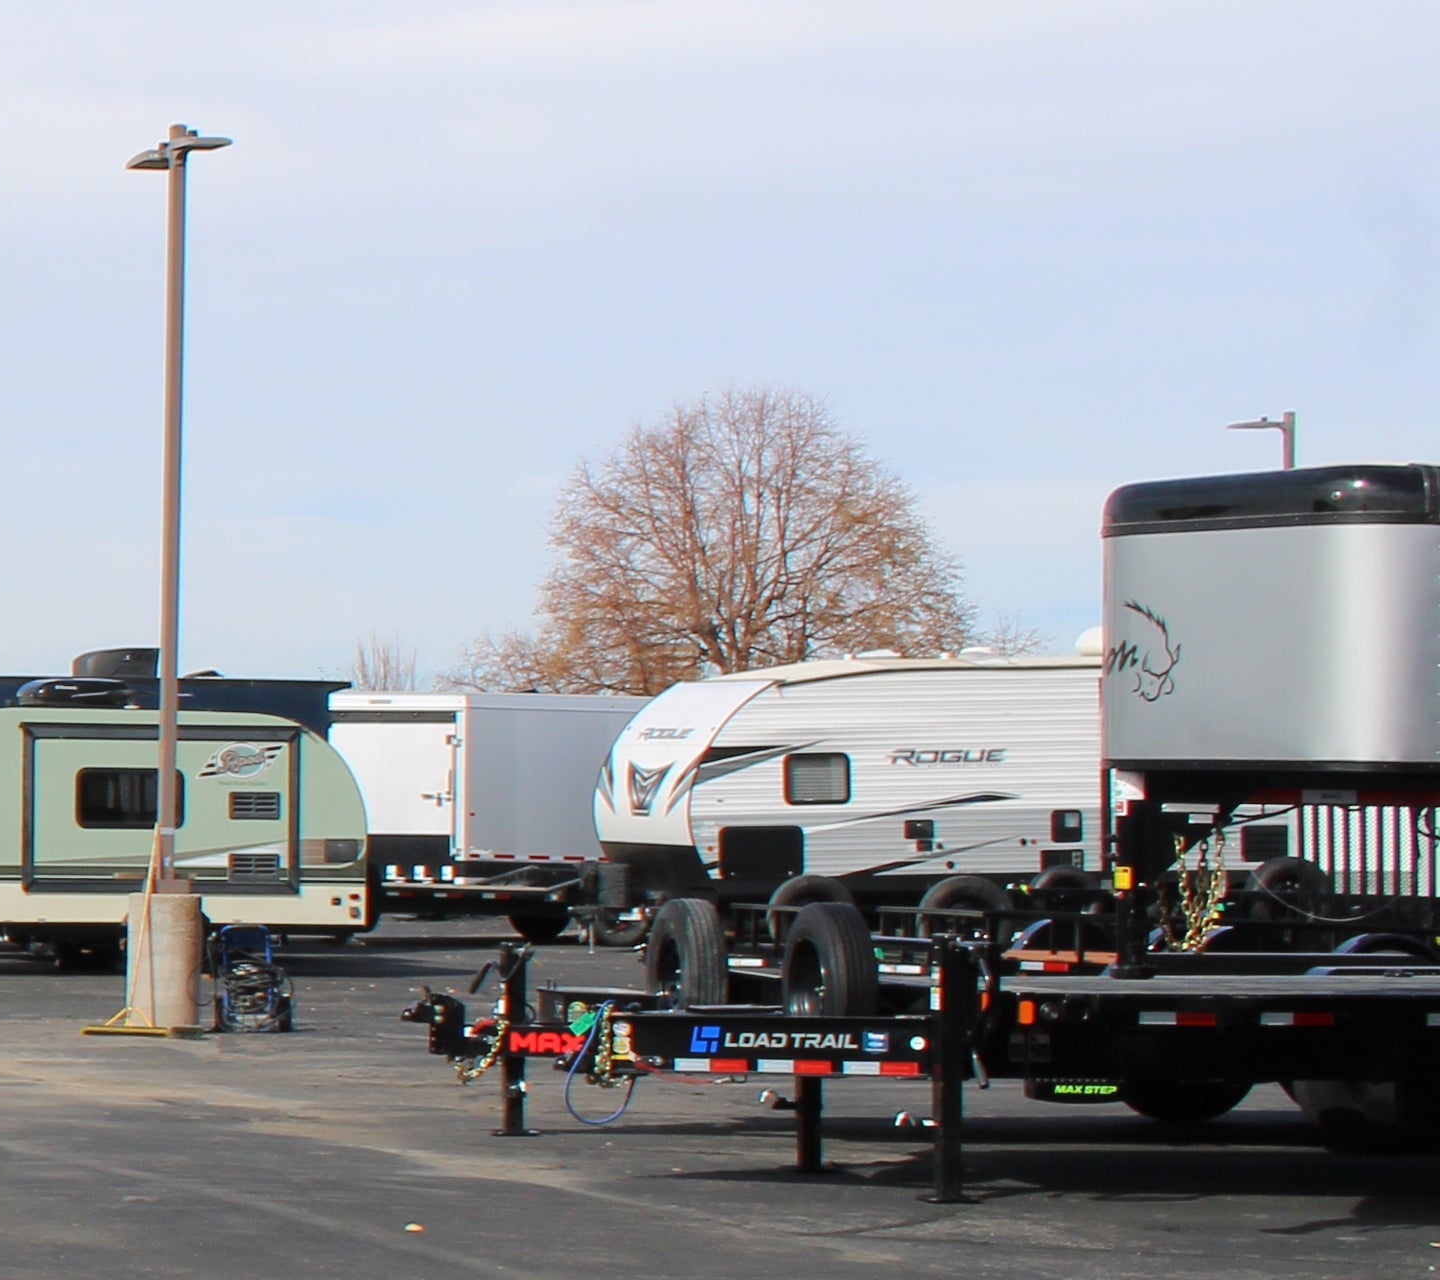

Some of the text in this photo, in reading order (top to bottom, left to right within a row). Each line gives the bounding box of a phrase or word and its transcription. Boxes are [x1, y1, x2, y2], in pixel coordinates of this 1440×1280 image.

[886, 748, 1007, 766] ROGUE
[724, 1032, 787, 1048] LOAD
[791, 1032, 859, 1049] TRAIL
[1054, 1085, 1118, 1094] MAX STEP
